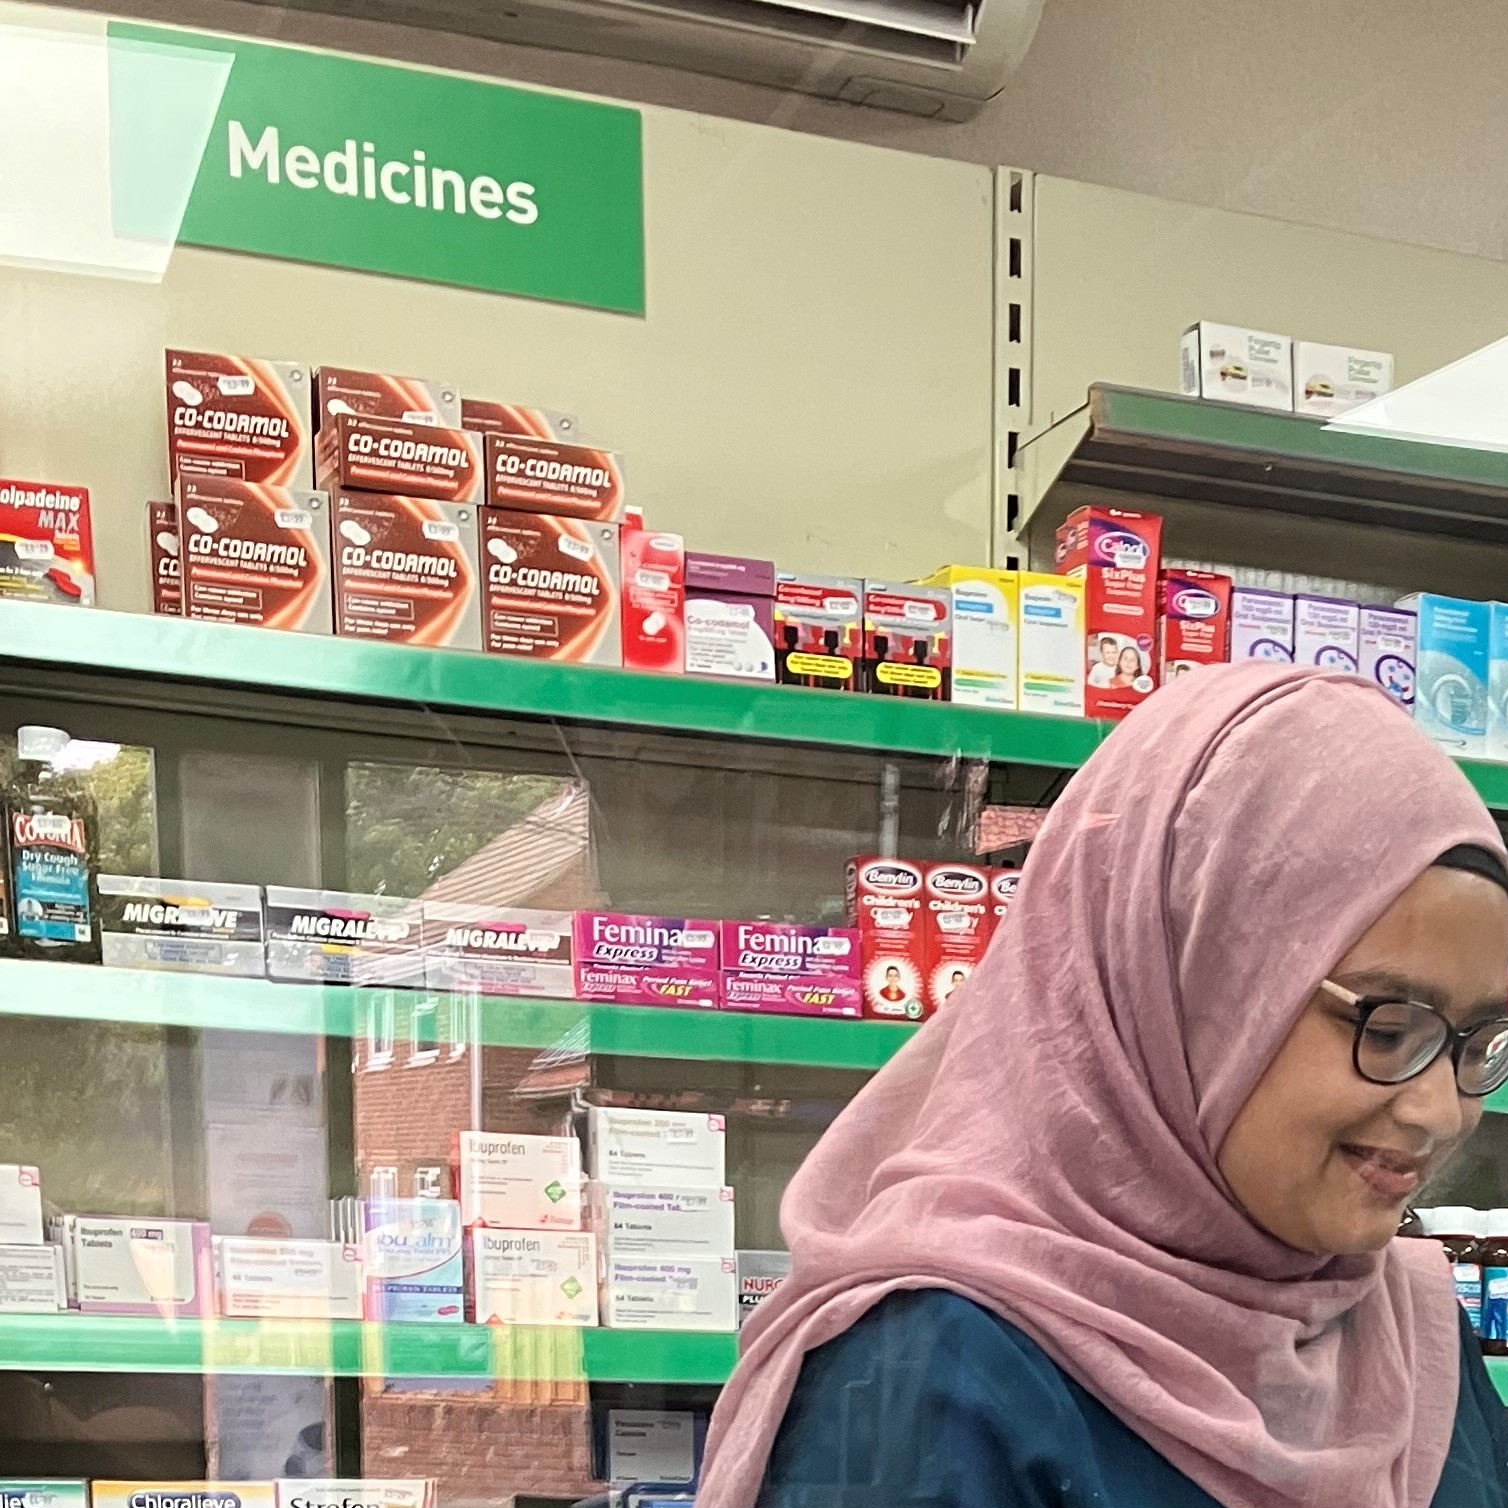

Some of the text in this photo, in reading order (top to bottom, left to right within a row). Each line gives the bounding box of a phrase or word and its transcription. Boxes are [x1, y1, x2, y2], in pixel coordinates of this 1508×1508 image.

[228, 121, 539, 225] Medicines
[174, 407, 289, 438] CO-CODAMOL
[348, 434, 469, 468] CO-CODAMOL
[496, 454, 611, 488] CO-CODAMOL
[0, 489, 80, 510] olpadeine
[37, 511, 80, 532] MAX
[189, 534, 307, 567] CO-CODAMOL
[342, 547, 457, 577] CO-CODAMOL
[489, 564, 599, 595] CO-CODAMOL
[22, 850, 78, 866] Dry Cough
[868, 871, 914, 887] Benylin
[936, 877, 979, 891] Benylin
[863, 895, 920, 909] Children's
[929, 900, 985, 914] Children's
[123, 903, 238, 928] MIGRVE
[593, 917, 682, 947] Femina
[738, 926, 821, 954] Femina
[595, 945, 655, 960] Express
[741, 954, 799, 969] Express
[580, 971, 637, 986] Feminax
[726, 978, 782, 993] Feminax
[660, 984, 692, 996] FAST
[804, 992, 835, 1005] FAST
[469, 1137, 525, 1156] Ibuprofen
[484, 1236, 540, 1252] Ibuprofen
